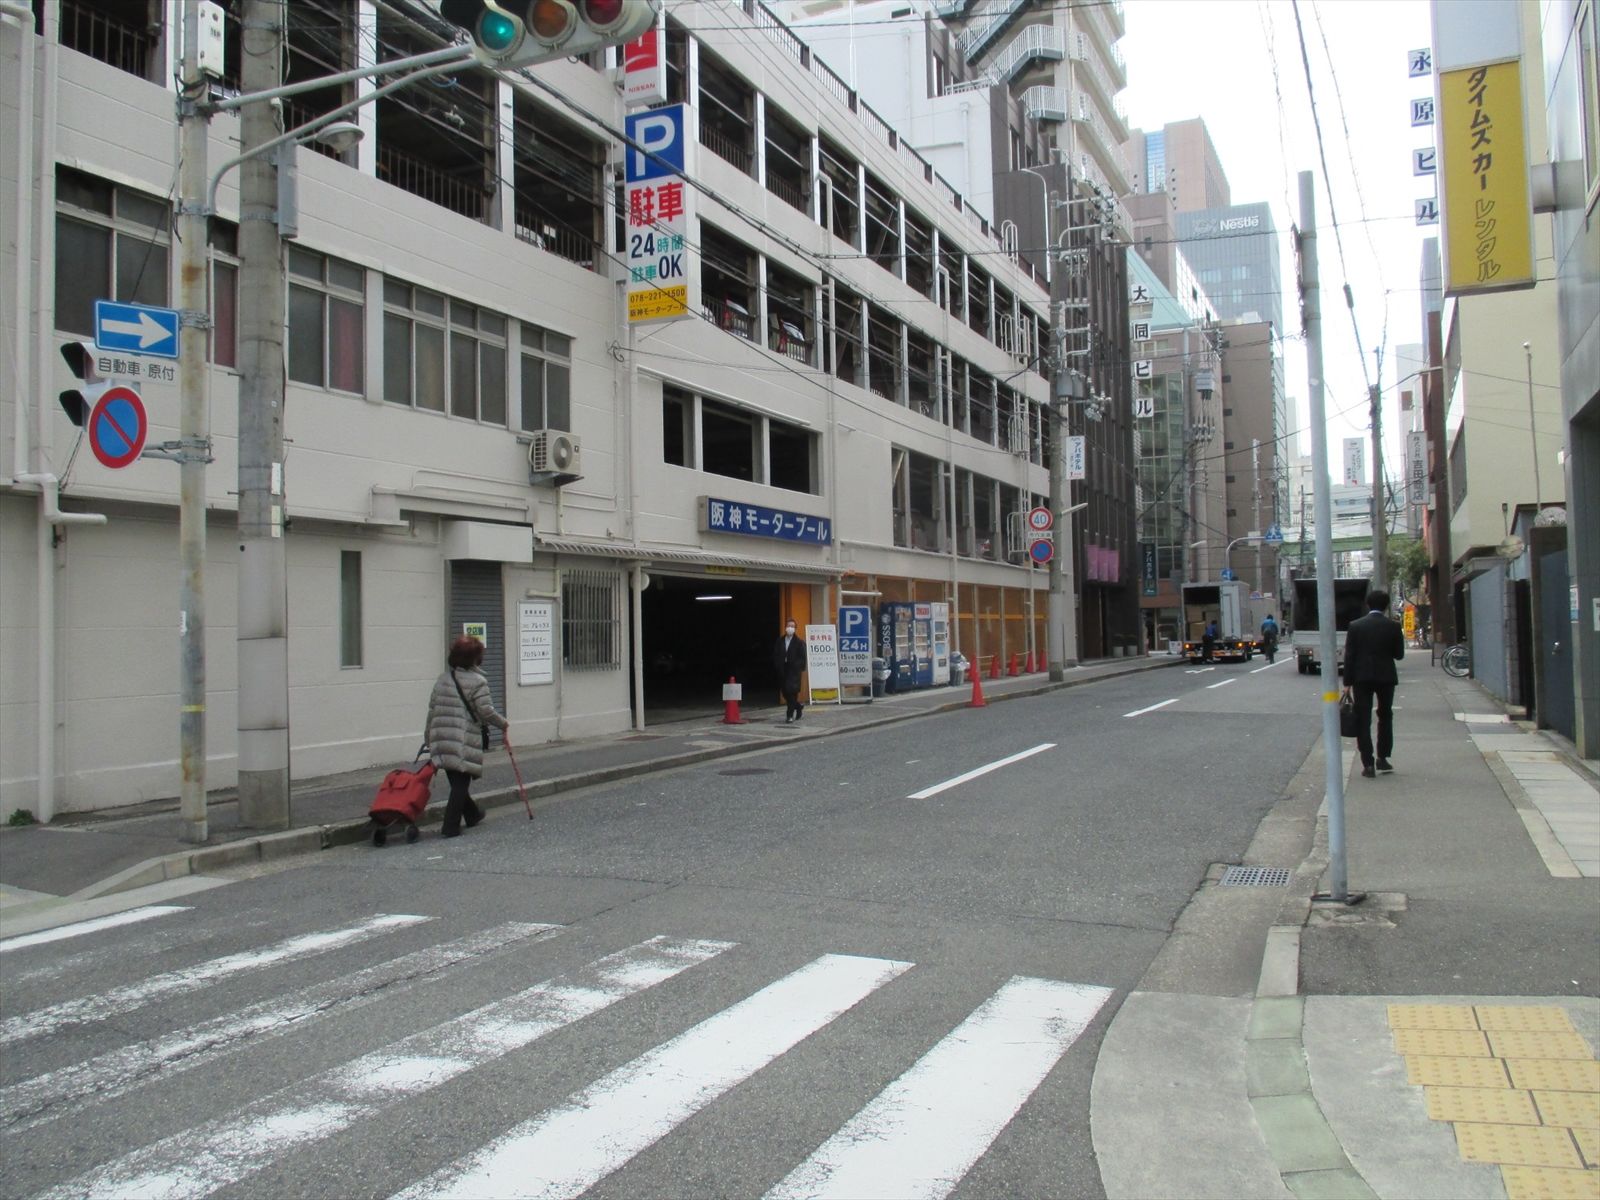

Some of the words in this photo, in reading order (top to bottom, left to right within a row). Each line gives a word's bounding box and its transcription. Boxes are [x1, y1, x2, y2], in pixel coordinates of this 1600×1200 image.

[628, 83, 656, 93] NISSAN
[635, 114, 676, 177] P
[1412, 50, 1439, 221] 永原ビル
[629, 182, 683, 227] 駐車
[631, 232, 683, 259] 24時間
[631, 254, 683, 283] 駐車OK
[630, 303, 685, 317] 阪神モータープール
[1132, 285, 1153, 416] 大同ビル
[711, 501, 828, 541] 阪神モータープール
[1033, 514, 1047, 525] 40
[845, 610, 863, 634] P
[841, 639, 868, 651] 24H
